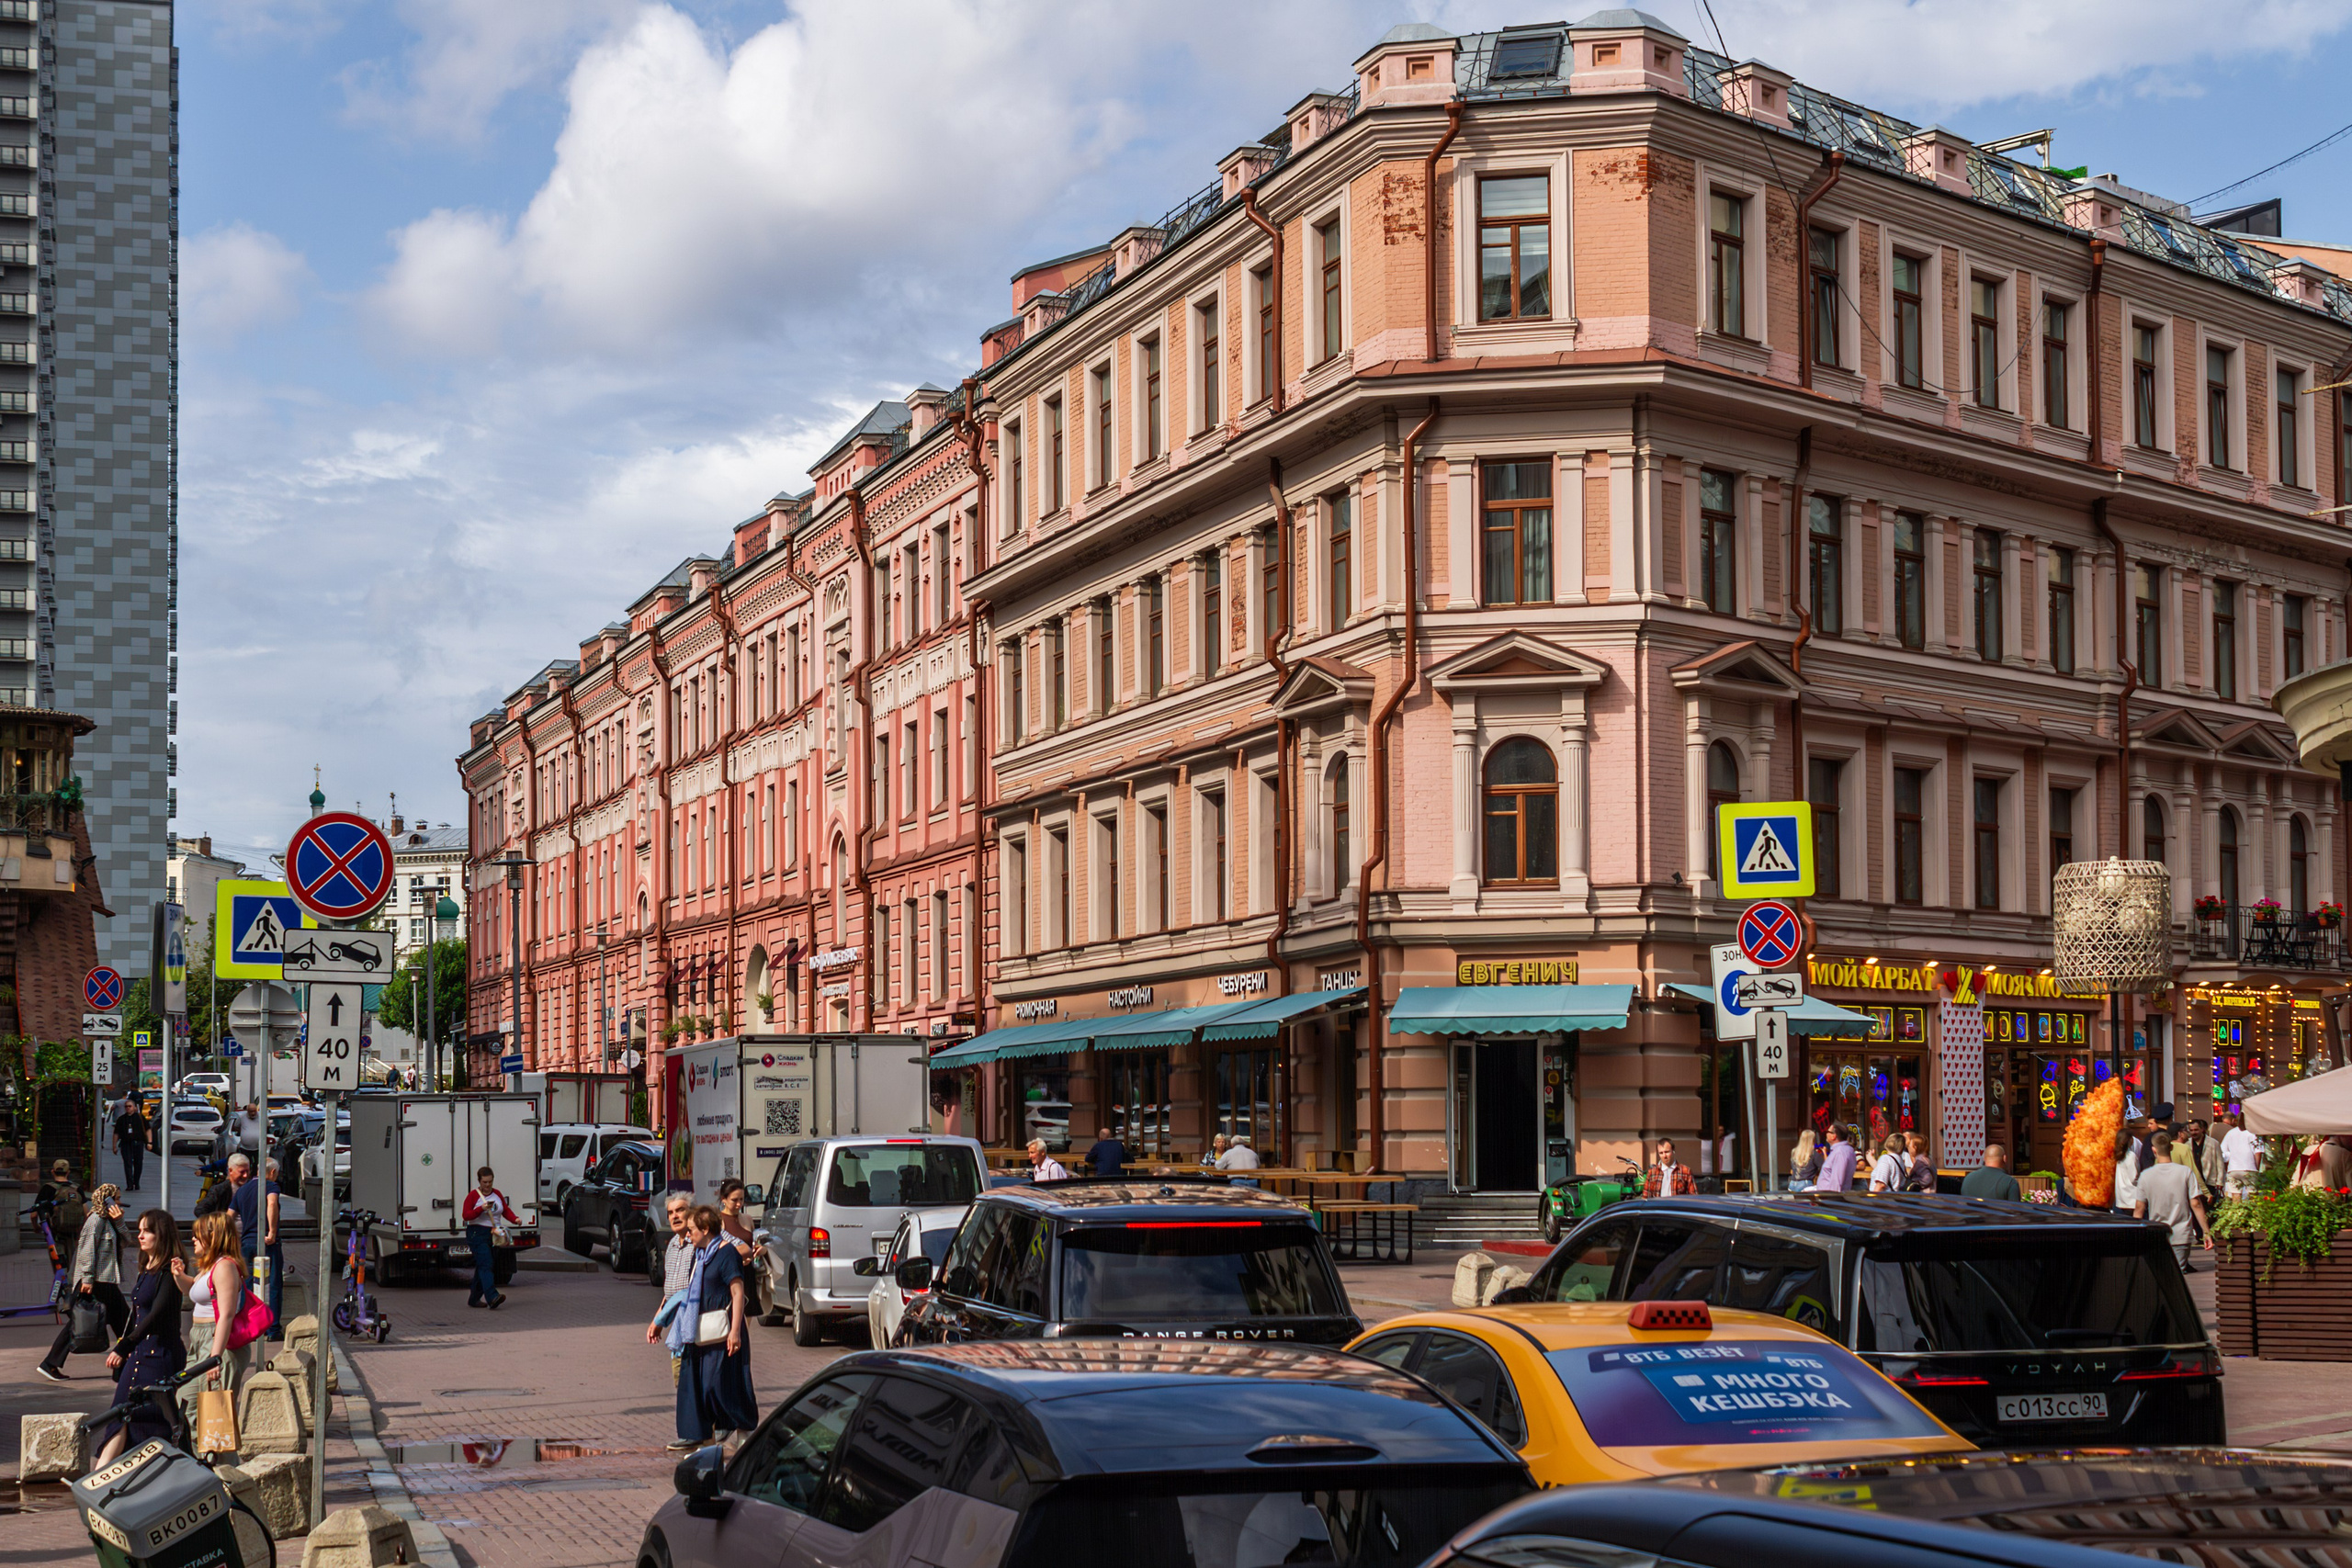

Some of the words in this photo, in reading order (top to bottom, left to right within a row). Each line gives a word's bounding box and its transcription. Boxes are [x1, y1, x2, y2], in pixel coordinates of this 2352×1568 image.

[1722, 950, 1746, 962] ЗОН
[1320, 970, 1358, 992] ТАНЦЫ
[1458, 961, 1577, 984] ЕВГЕНИЧ
[1809, 958, 1859, 988] МОЙ
[1871, 964, 1936, 991] АРБАТ
[1217, 972, 1266, 994] ЧЕБУРЕКИ
[1984, 972, 2025, 997] МОЯ
[1108, 985, 1151, 1008] НАСТОЙКИ
[1015, 999, 1056, 1019] РЮМОЧНАЯ
[317, 1038, 349, 1059] 40
[1763, 1045, 1782, 1059] 40
[96, 1063, 108, 1072] 25
[323, 1066, 341, 1082] М
[720, 1064, 734, 1077] smart
[1768, 1064, 1779, 1073] М
[1216, 1329, 1295, 1340] ROVER
[1624, 1350, 1671, 1364] ВТБ
[1677, 1346, 1746, 1359] ВЕЗЁТ
[1783, 1358, 1824, 1369] ВТБ
[1712, 1372, 1830, 1390] МНОГО
[1689, 1393, 1852, 1413] КЕШБЭКА
[2083, 1394, 2101, 1410] 90
[179, 1548, 224, 1568] СТАВКА
